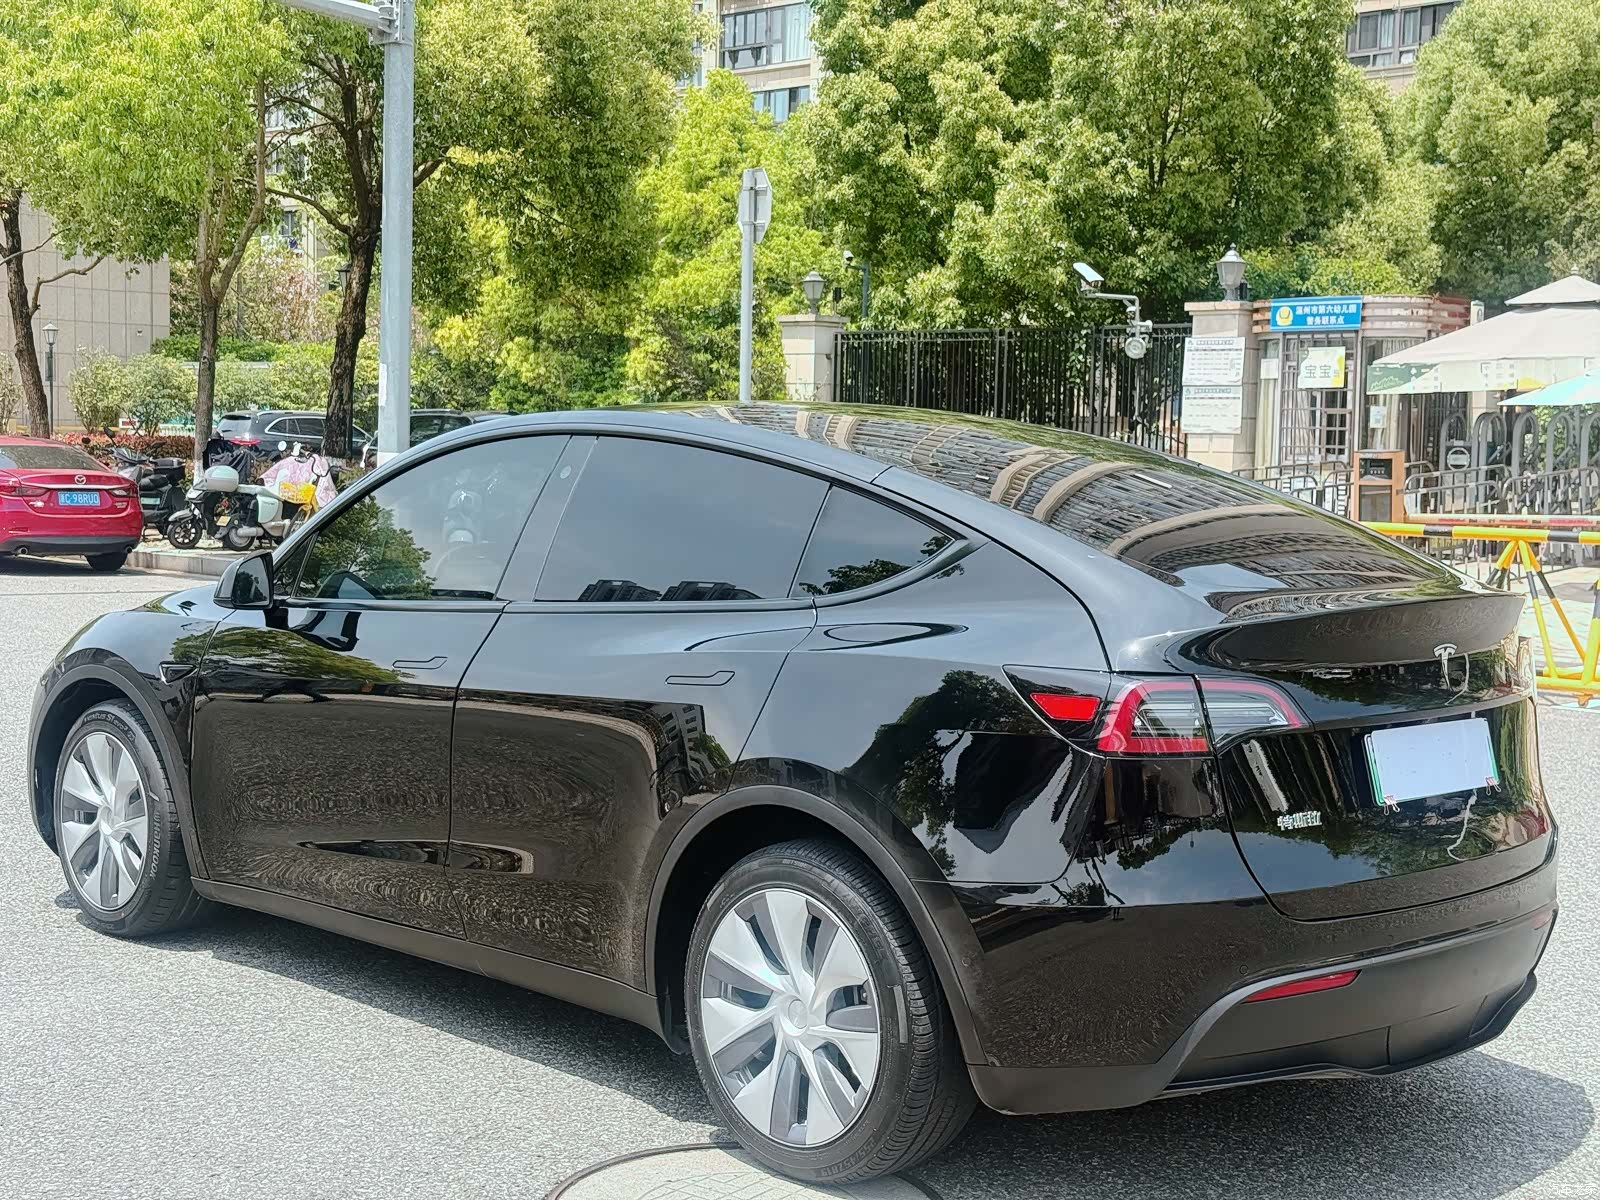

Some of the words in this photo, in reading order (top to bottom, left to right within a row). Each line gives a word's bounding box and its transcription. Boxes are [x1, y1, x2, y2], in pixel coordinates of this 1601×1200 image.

[1295, 303, 1357, 315] 温州市第六幼儿园
[1276, 810, 1322, 831] 特斯拉
